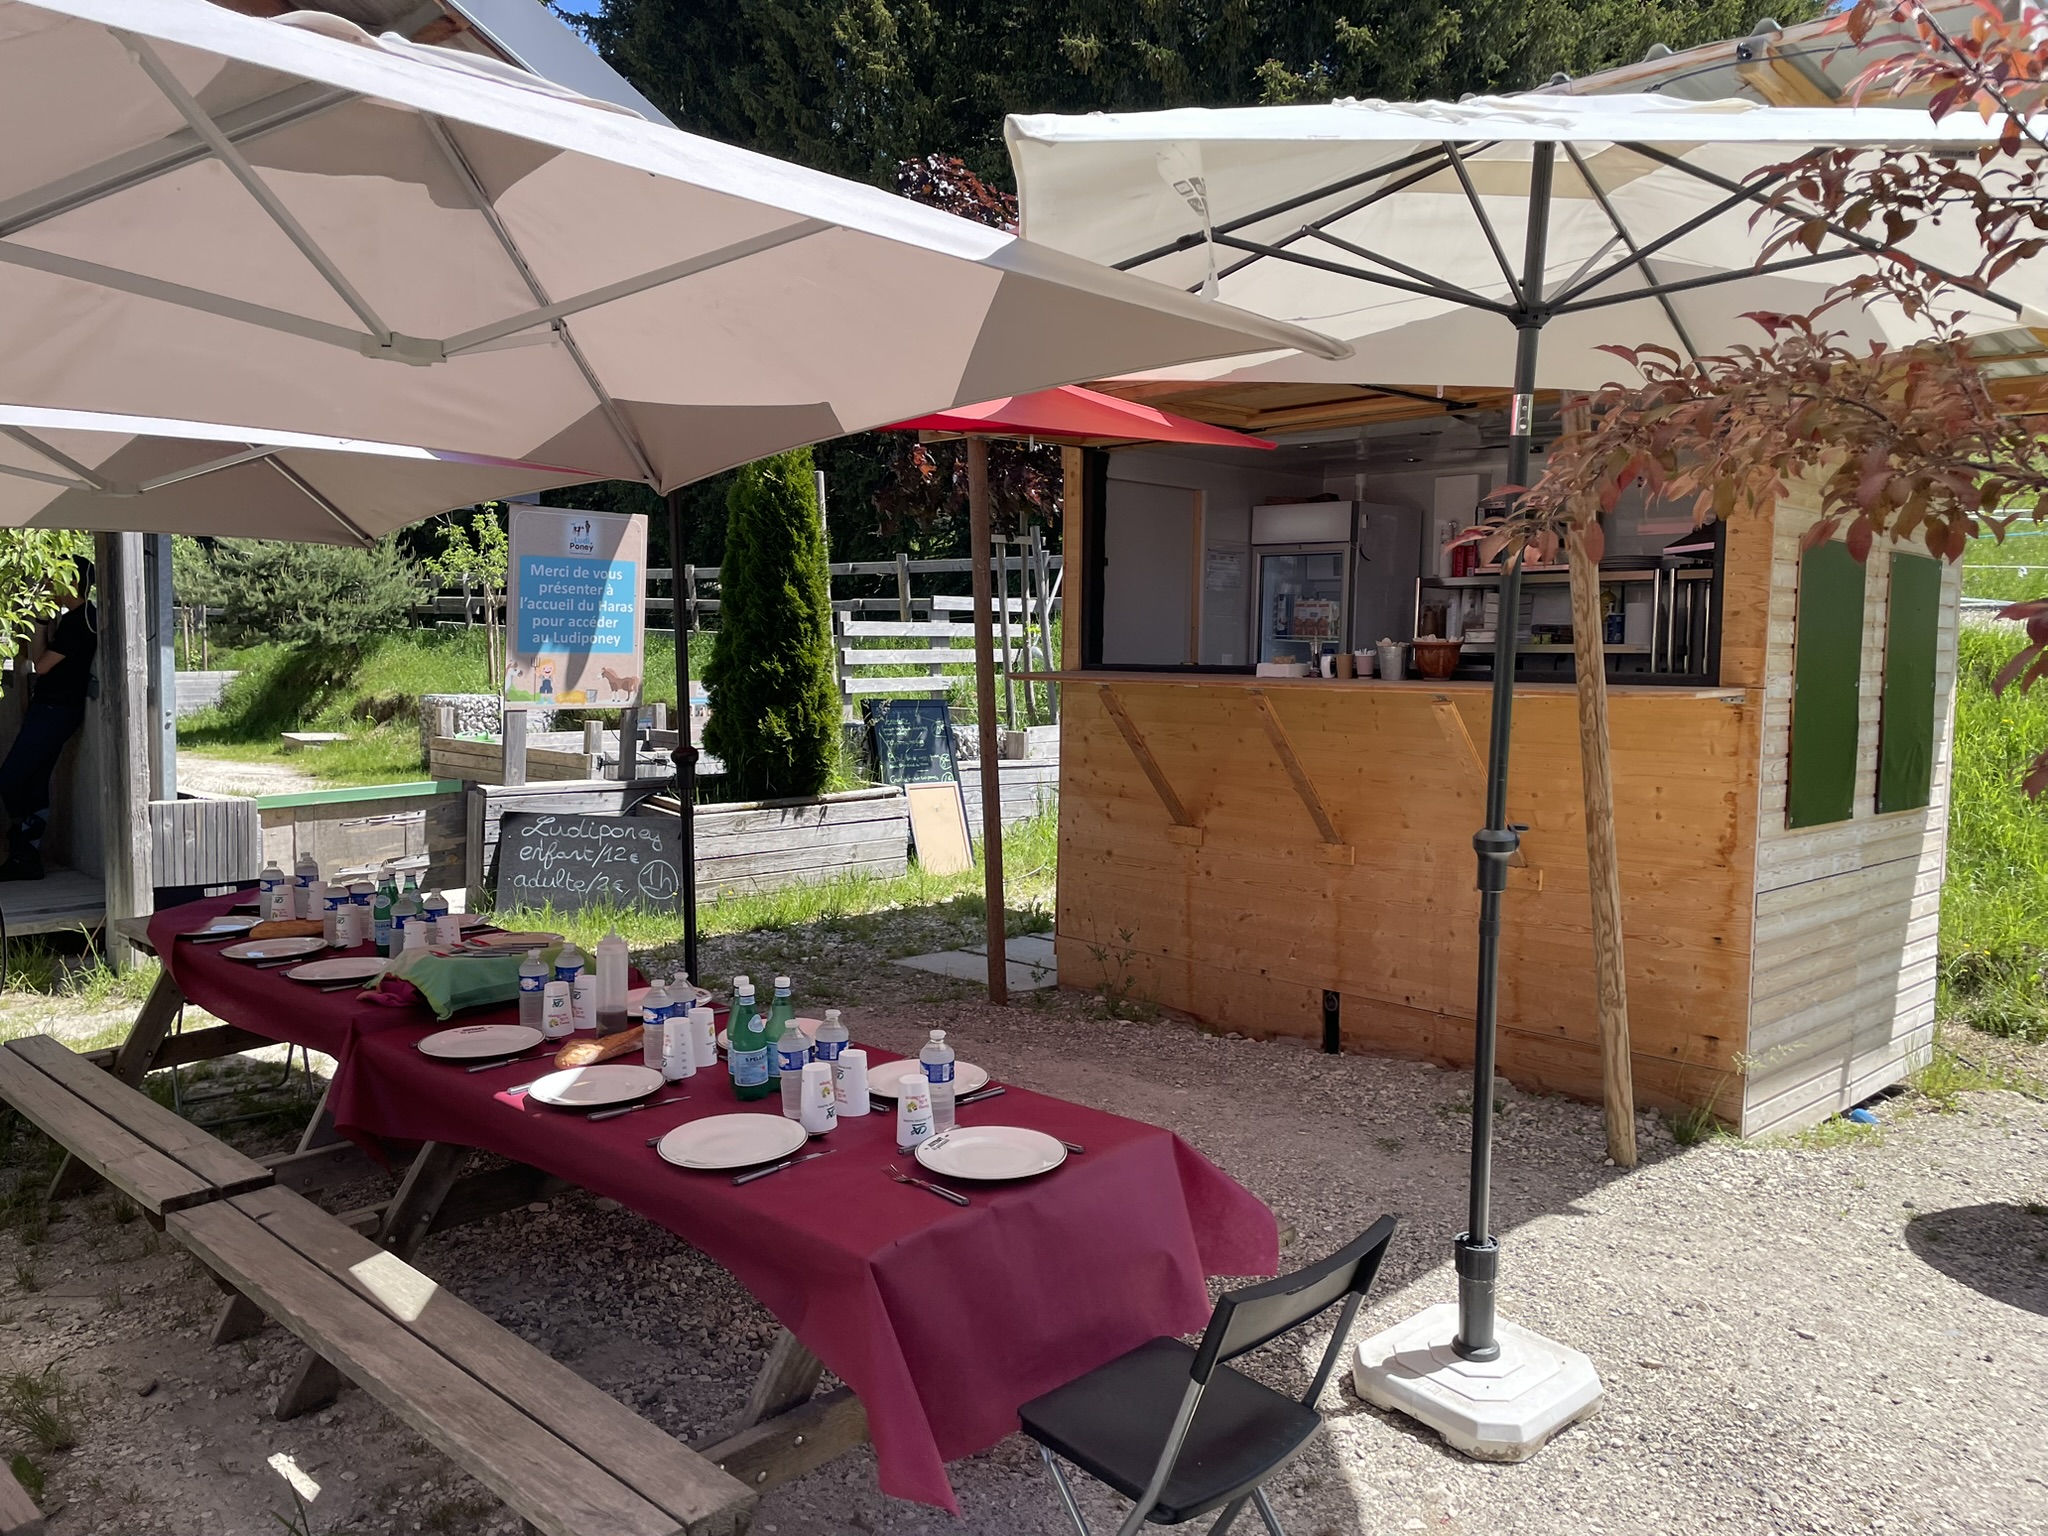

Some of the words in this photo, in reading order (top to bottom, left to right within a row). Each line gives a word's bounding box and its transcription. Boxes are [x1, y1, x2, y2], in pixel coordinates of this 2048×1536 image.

[569, 542, 594, 552] Poney
[530, 564, 569, 578] Merci
[573, 566, 590, 579] de
[593, 569, 623, 580] vous
[538, 582, 604, 596] présenter
[606, 583, 614, 596] à
[577, 599, 595, 611] du
[599, 600, 634, 613] Haras
[532, 617, 564, 629] pour
[568, 615, 619, 629] accéder
[532, 633, 549, 644] au
[553, 631, 621, 647] Ludiponey
[521, 815, 663, 852] Ludiponey
